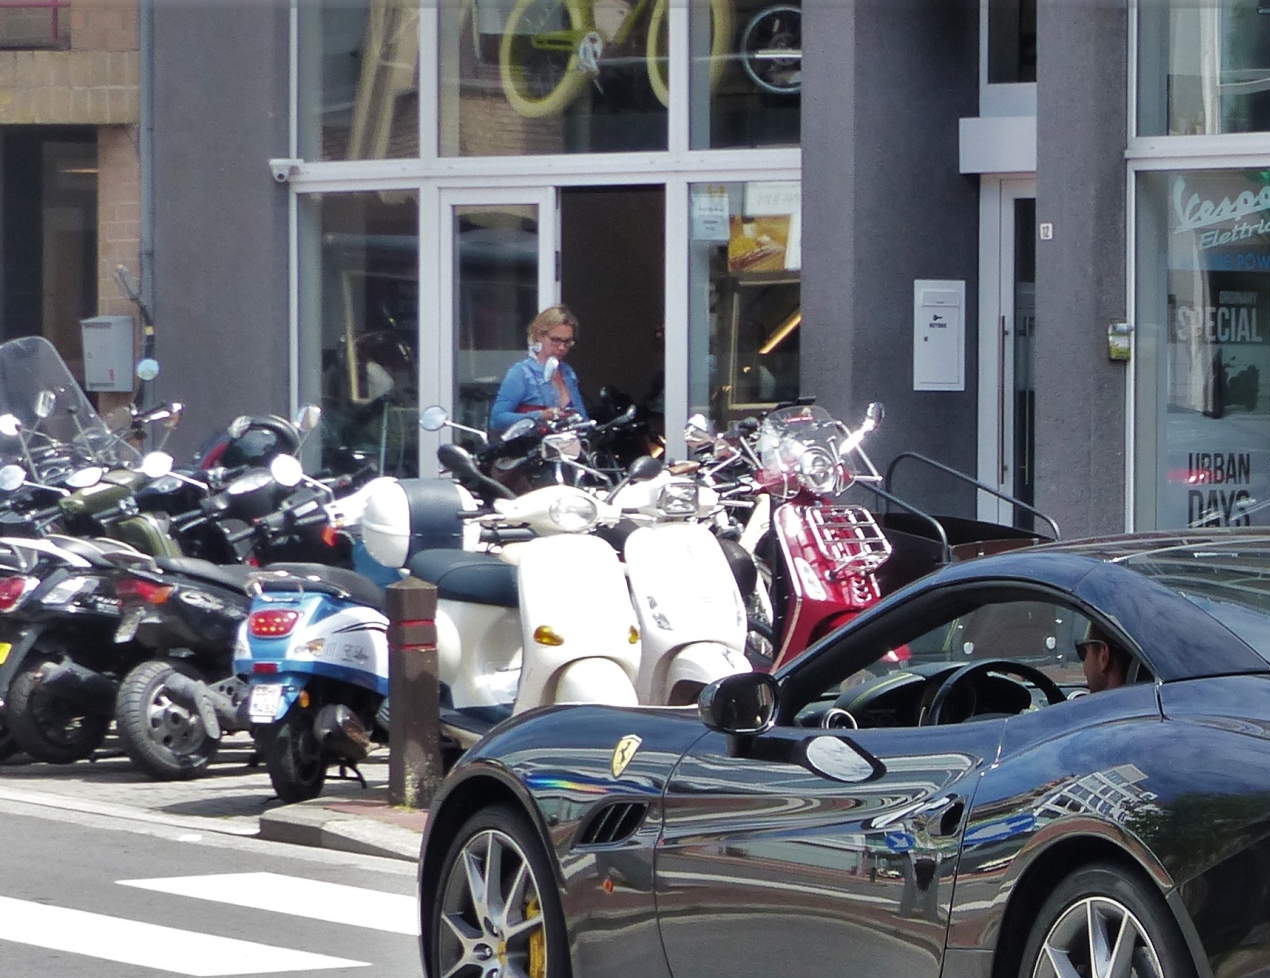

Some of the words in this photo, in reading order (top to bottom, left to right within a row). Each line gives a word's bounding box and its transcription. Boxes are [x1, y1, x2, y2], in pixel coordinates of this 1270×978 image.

[1177, 305, 1263, 342] SPECIAL
[1187, 452, 1250, 485] URBAN
[1187, 489, 1251, 528] DAYS
